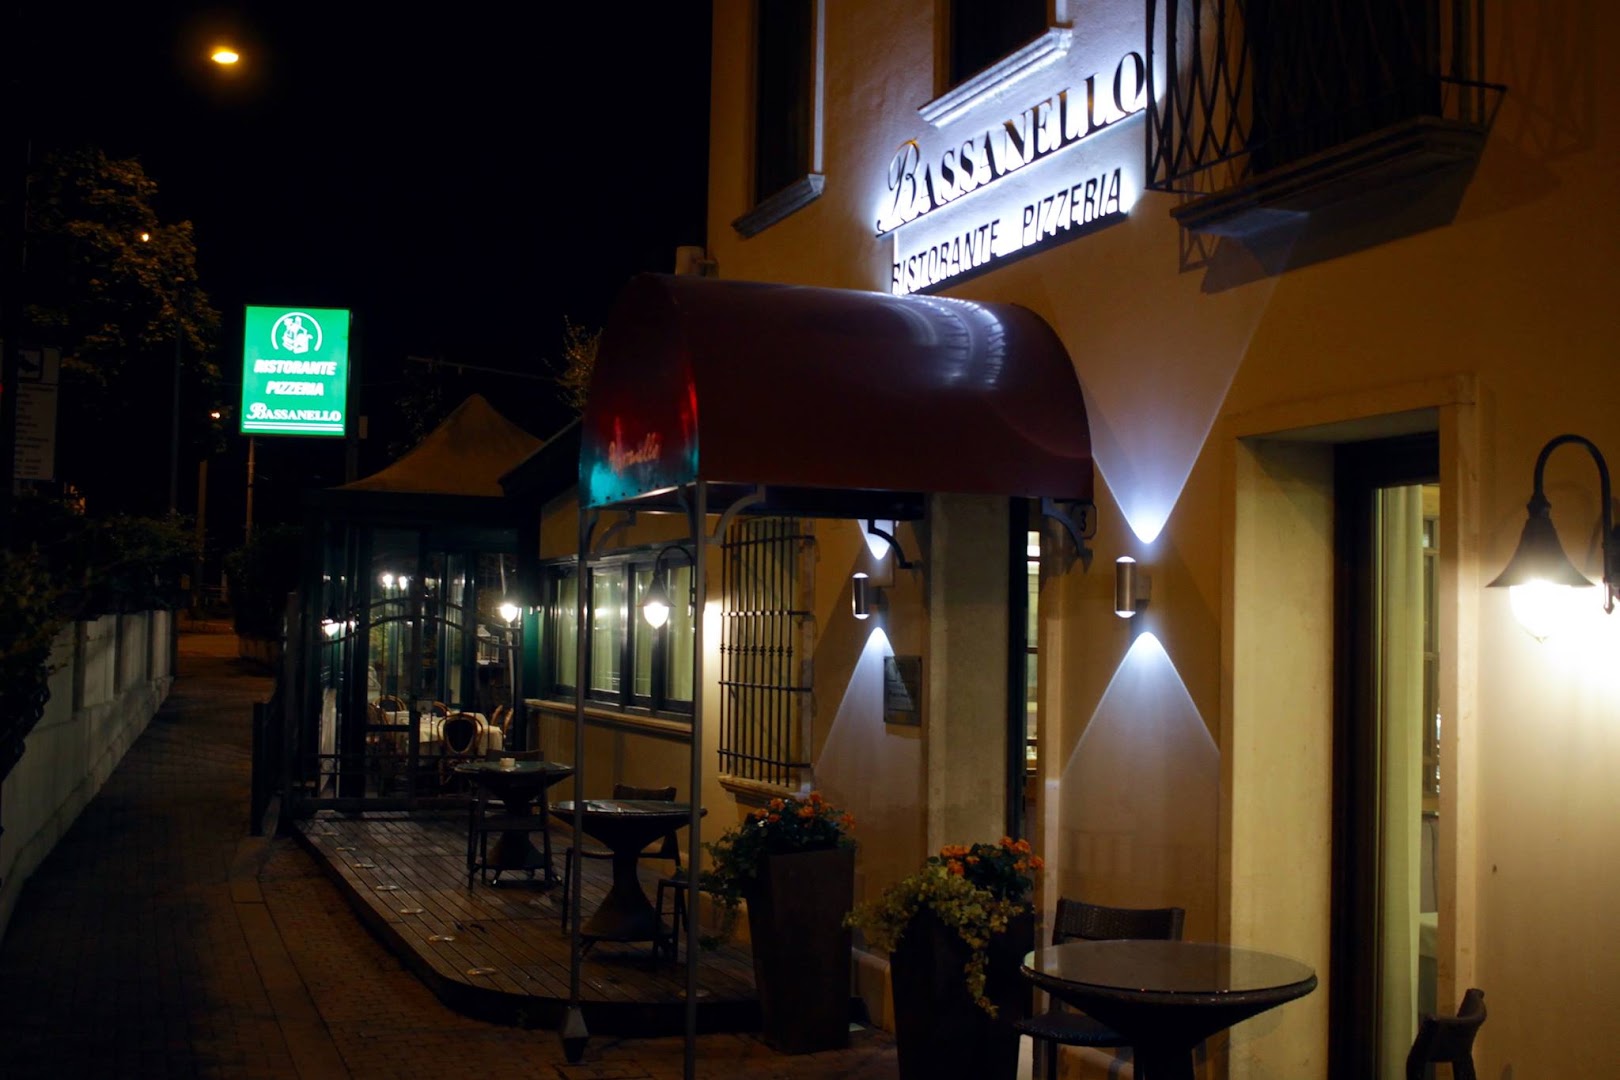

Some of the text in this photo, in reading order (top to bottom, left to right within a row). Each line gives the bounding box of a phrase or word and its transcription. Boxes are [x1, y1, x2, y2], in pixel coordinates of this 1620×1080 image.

[877, 51, 1146, 234] BASSANELLO
[892, 167, 1122, 294] RISTORANTE PIZZERIA
[254, 359, 337, 376] RISTORANTE
[265, 381, 324, 396] PIZZERIA
[246, 402, 342, 422] BASSANELLO
[1080, 511, 1087, 532] 3
